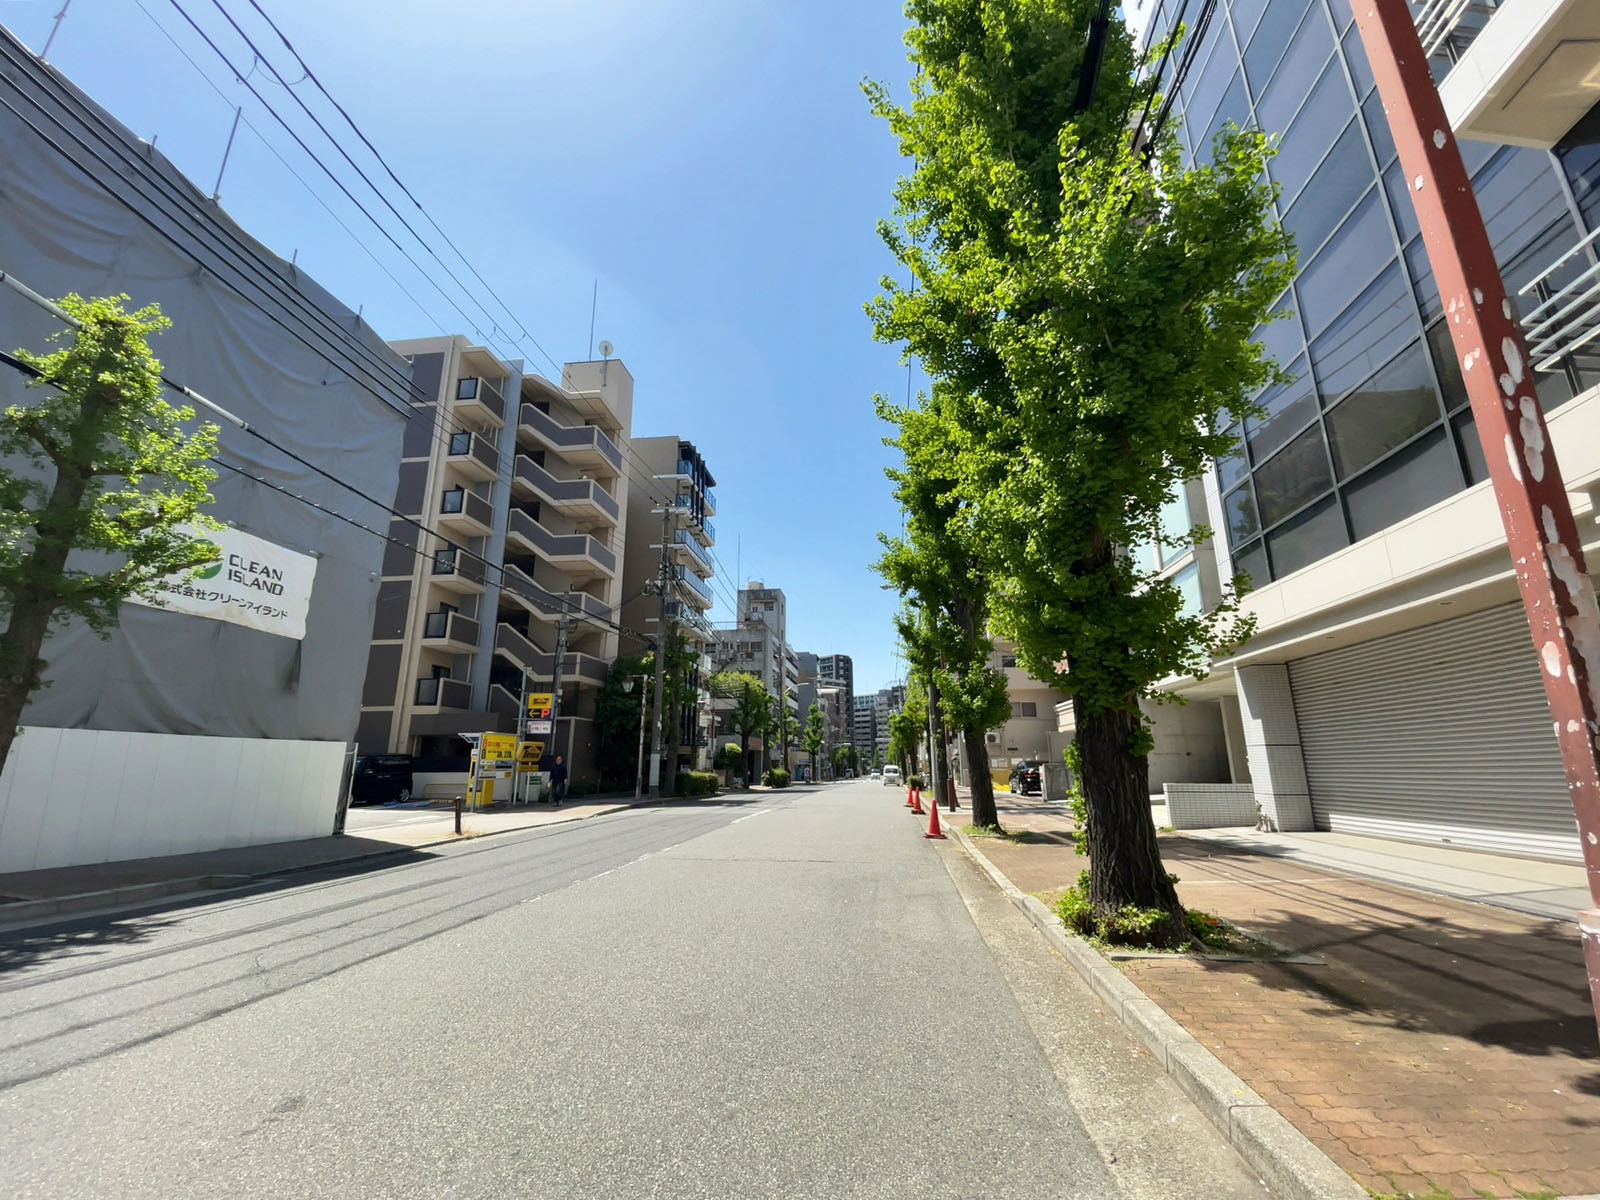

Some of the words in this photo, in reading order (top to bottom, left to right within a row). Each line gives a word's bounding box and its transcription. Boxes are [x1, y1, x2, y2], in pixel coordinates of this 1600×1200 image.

[229, 554, 283, 581] CLEAN
[228, 569, 284, 595] ISLAND
[159, 583, 288, 620] 式会社クリーンアイランド
[541, 708, 550, 718] P
